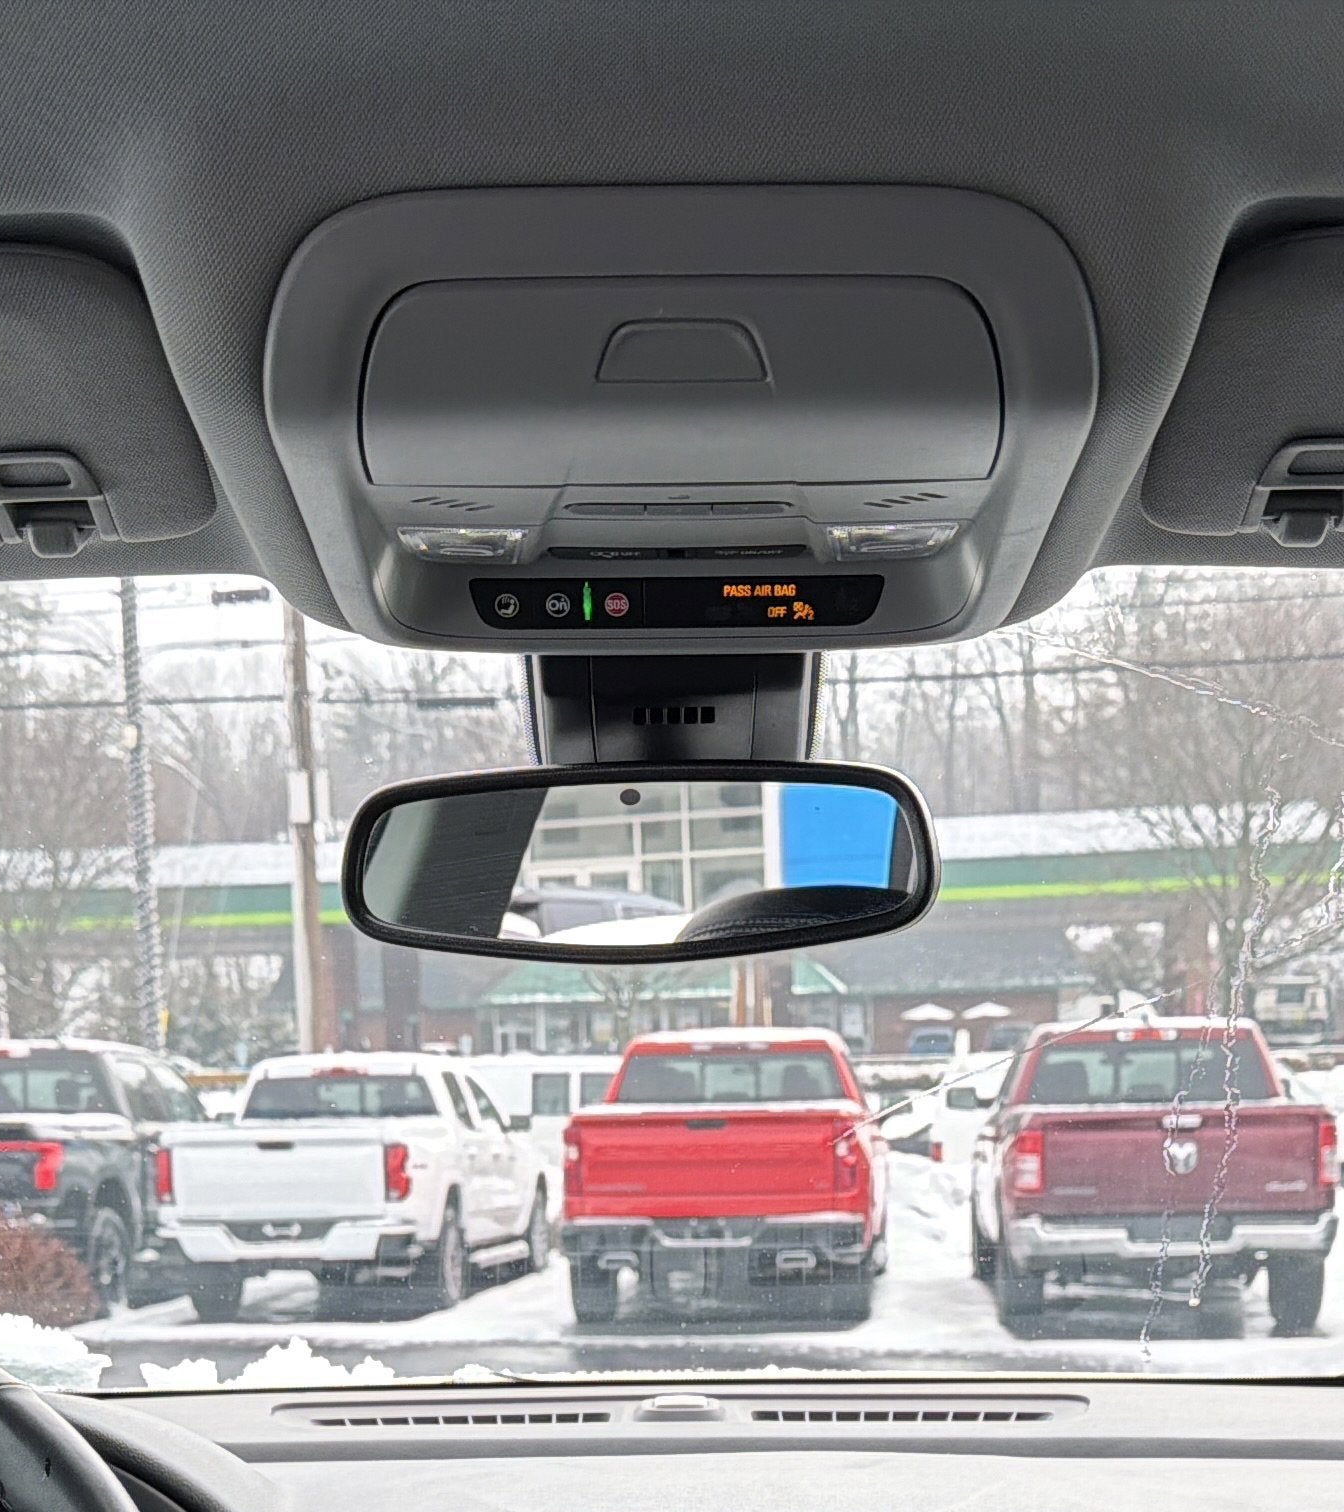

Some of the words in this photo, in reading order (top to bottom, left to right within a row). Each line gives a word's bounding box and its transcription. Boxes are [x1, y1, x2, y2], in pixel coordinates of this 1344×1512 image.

[723, 584, 752, 597] PASS
[754, 584, 772, 597] AIR
[774, 584, 797, 597] BAG
[606, 599, 626, 611] SOS
[768, 606, 787, 618] OFF
